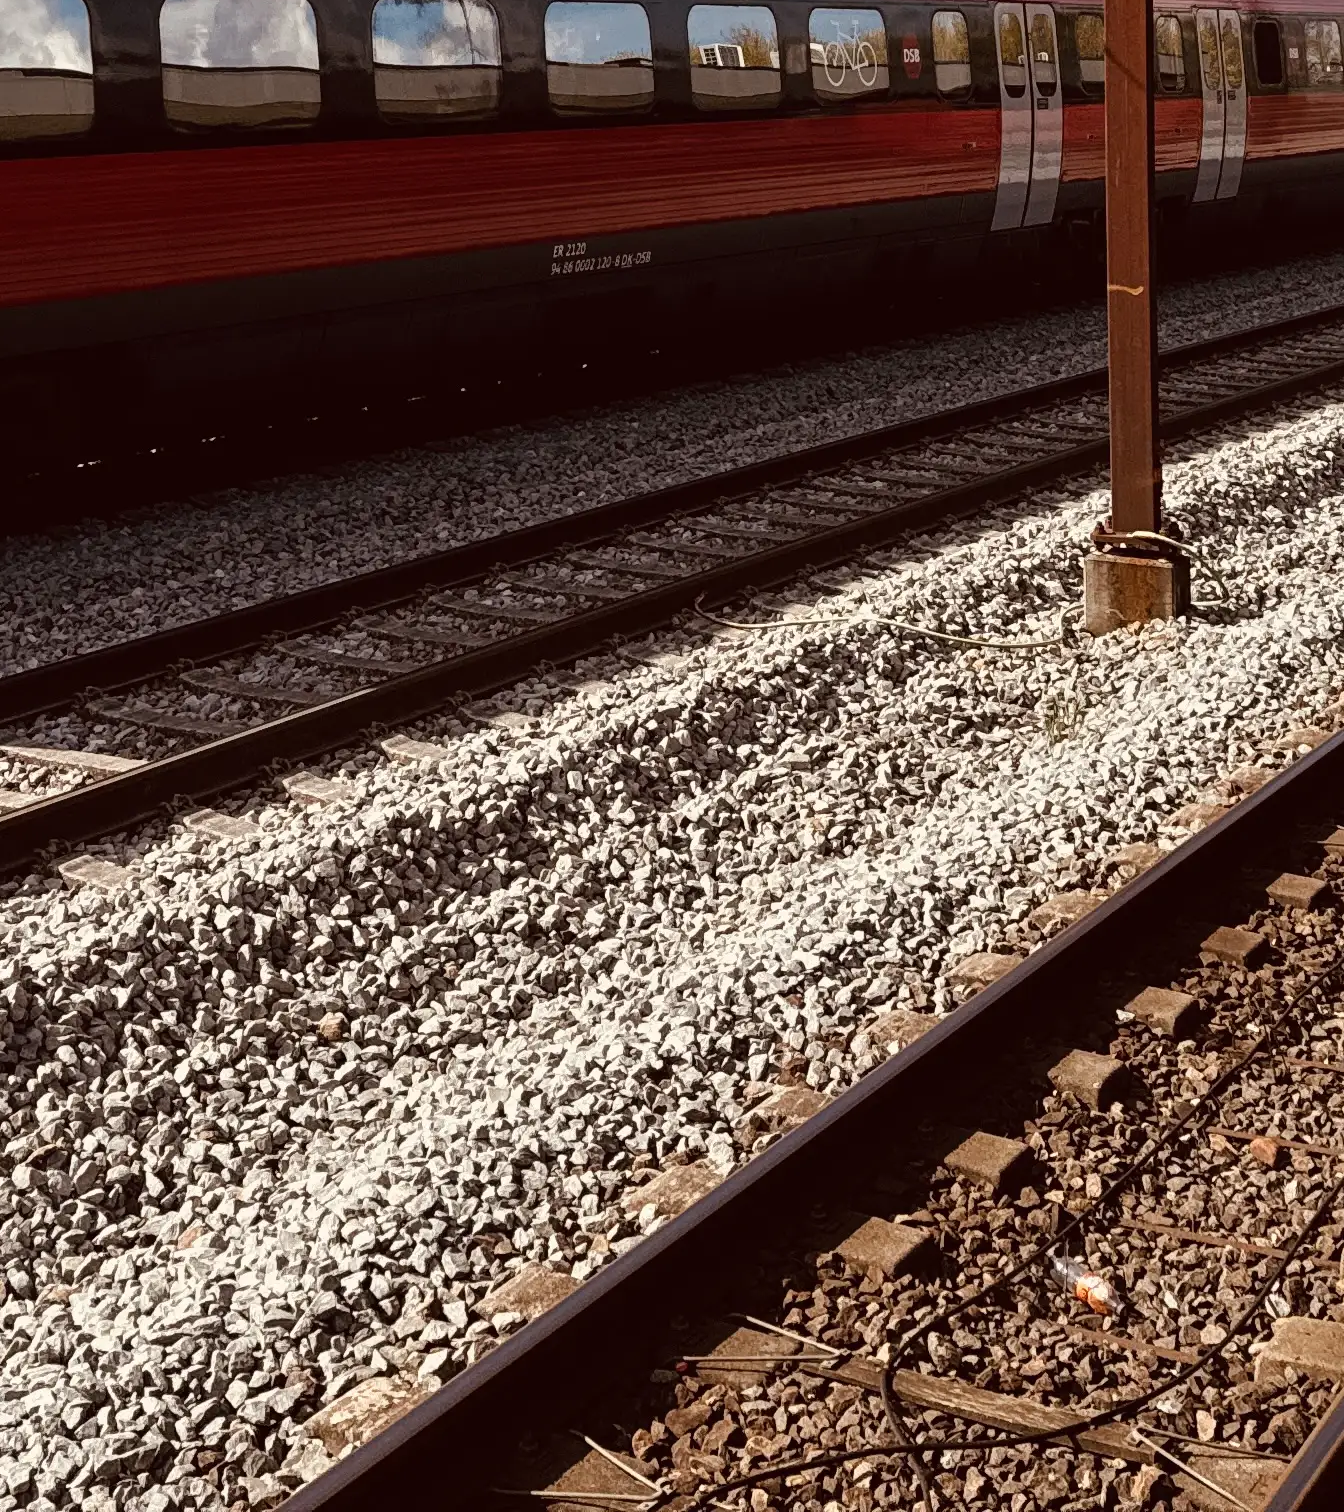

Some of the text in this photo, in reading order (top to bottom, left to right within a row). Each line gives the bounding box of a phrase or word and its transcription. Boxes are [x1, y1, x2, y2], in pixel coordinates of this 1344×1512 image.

[903, 48, 921, 63] DSB
[553, 242, 587, 258] ER 2120
